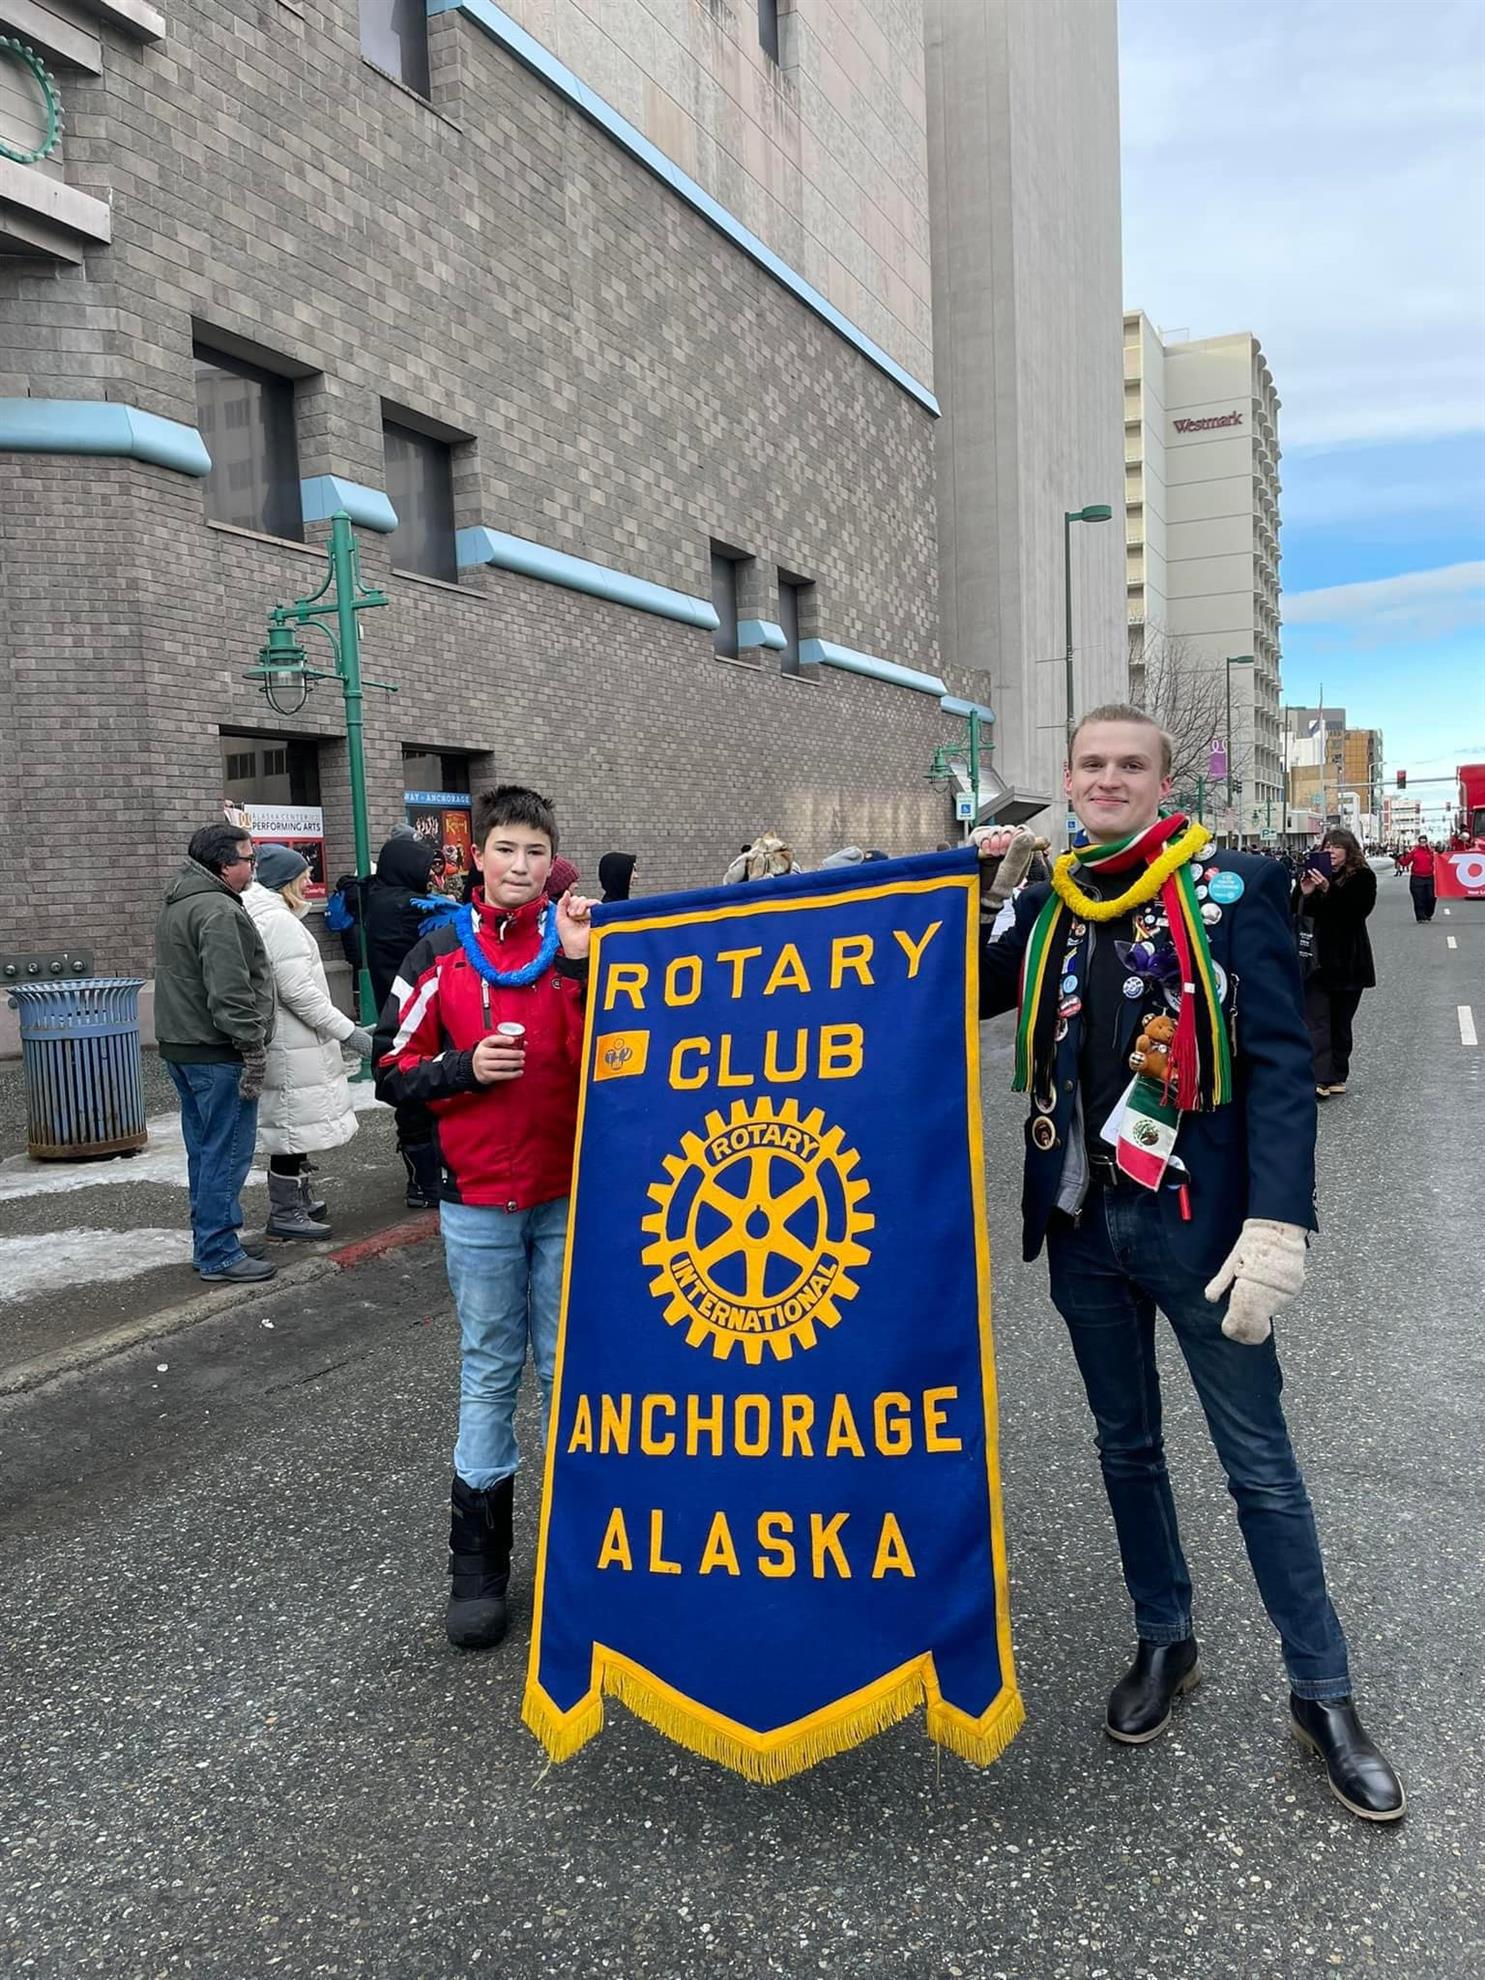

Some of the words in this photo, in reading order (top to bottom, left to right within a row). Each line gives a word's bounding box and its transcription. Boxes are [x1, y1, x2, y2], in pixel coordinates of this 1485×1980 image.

[1173, 410, 1243, 434] Westmark
[252, 821, 302, 832] PERFORMING
[303, 822, 321, 832] ARTS
[426, 793, 470, 803] ANCHORAGE
[603, 920, 943, 1010] ROTARY
[668, 1023, 864, 1090] CLUB
[710, 1123, 820, 1160] ROTARY
[670, 1257, 838, 1332] INTERNATIONAL
[567, 1386, 962, 1457] ANCHORAGE
[597, 1507, 916, 1579] ALASKA
